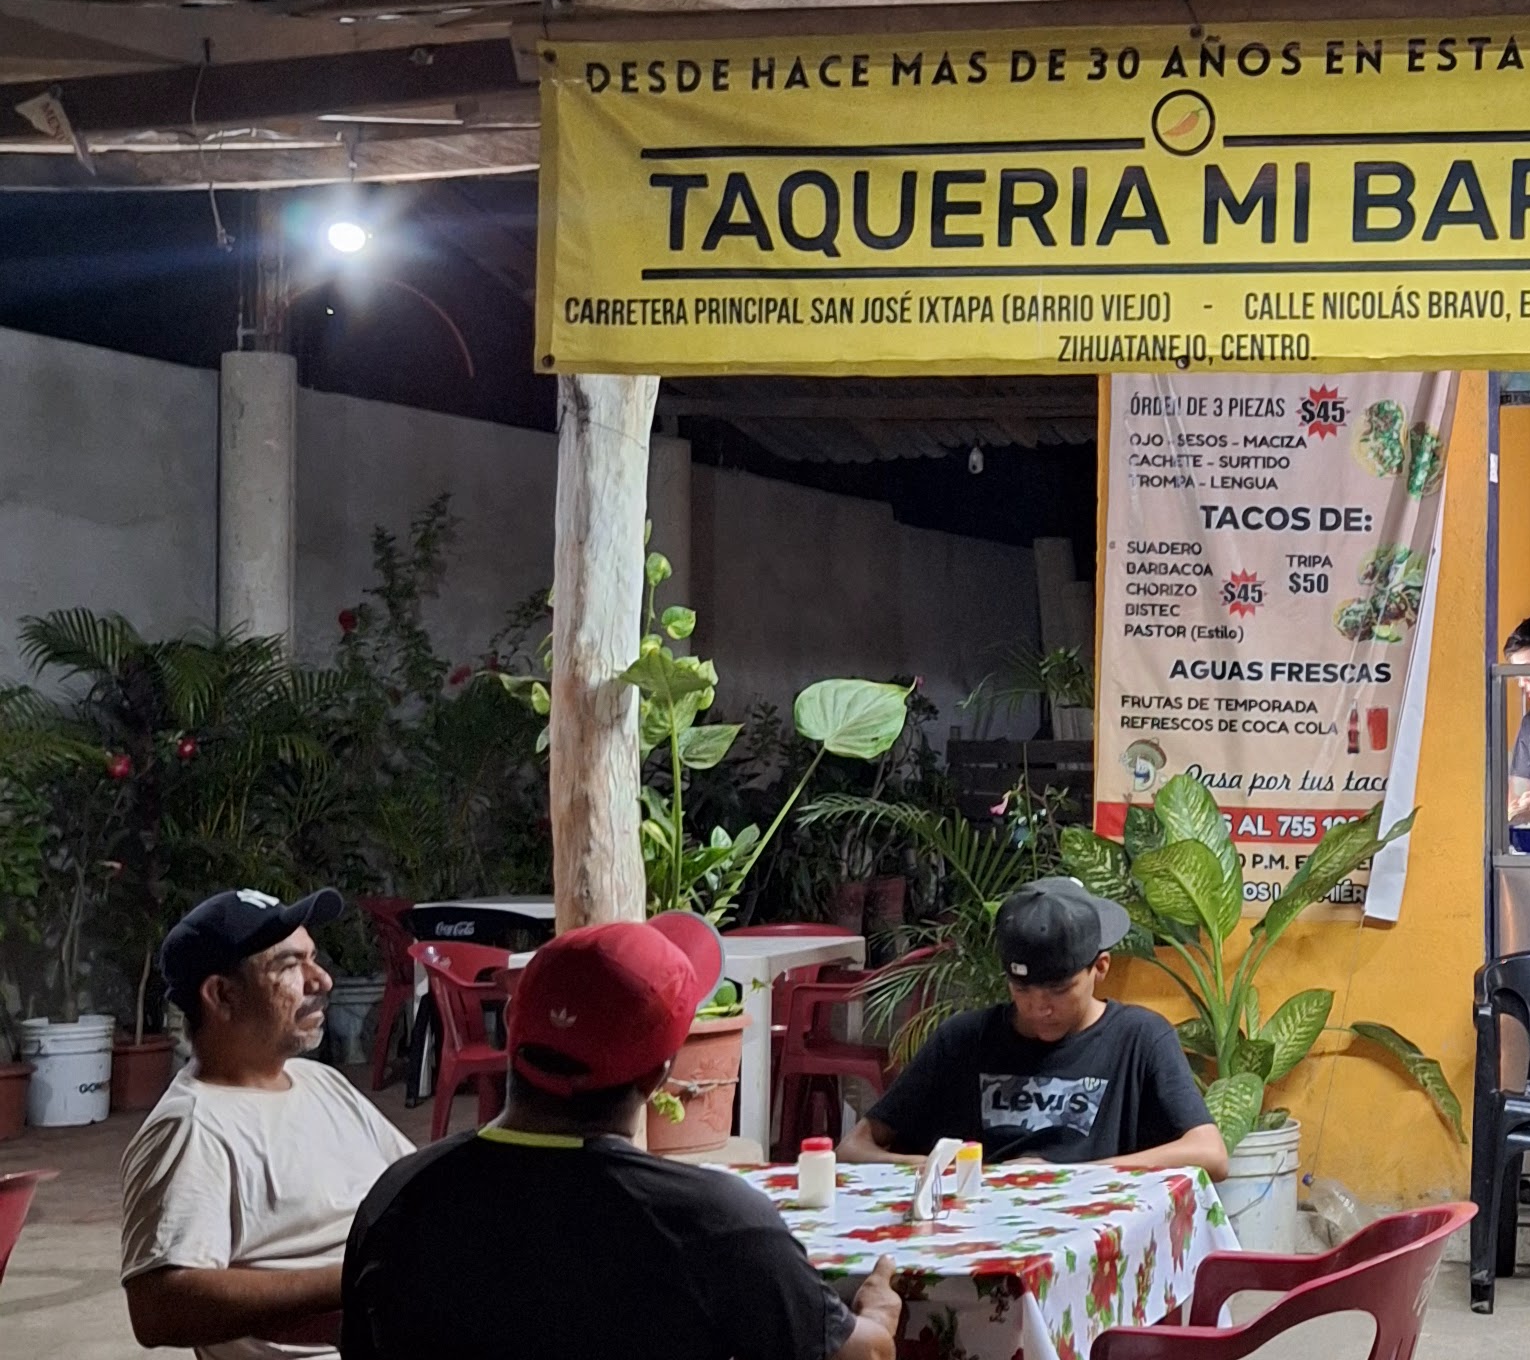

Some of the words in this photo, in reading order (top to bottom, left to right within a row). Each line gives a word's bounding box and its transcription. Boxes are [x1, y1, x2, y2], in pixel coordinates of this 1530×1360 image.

[586, 58, 730, 93] DESDE
[752, 54, 870, 89] HACE
[892, 50, 987, 85] MAS
[1011, 48, 1066, 82] DE
[1088, 45, 1140, 80] 30
[1161, 36, 1302, 80] AÑOS
[1326, 39, 1383, 74] EN
[1407, 34, 1526, 72] ESTA
[649, 166, 1170, 257] TAQUERIA
[1203, 162, 1310, 244] MI
[565, 297, 687, 325] CARRETERA
[695, 298, 803, 324] PRINCIPAL
[811, 298, 853, 323] SAN
[861, 291, 912, 323] JOSÉ
[919, 296, 993, 323] IXTAPA
[1003, 294, 1093, 324] (BARRIO
[1102, 292, 1170, 322] VIEJO)
[1245, 292, 1314, 320] CALLE
[1323, 285, 1420, 319] NICOLÁS
[1429, 290, 1510, 322] BRAVO,
[1058, 334, 1214, 366] ZIHUATANEJO,
[1221, 333, 1317, 361] CENTRO.
[1187, 397, 1207, 416] DE
[1214, 398, 1222, 416] 3
[1229, 398, 1284, 417] PIEZAS
[1300, 398, 1345, 424] $45
[1130, 433, 1163, 446] OJO
[1178, 433, 1227, 447] SESOS
[1244, 436, 1306, 448] MACIZA
[1219, 456, 1290, 469] SURTIDO
[1211, 476, 1278, 489] LENGUA
[1200, 506, 1310, 531] TACOS
[1320, 508, 1372, 531] DE:
[1128, 541, 1202, 555] SUADERO
[1127, 562, 1213, 576] BARBACOA
[1286, 555, 1332, 568] TRIPA
[1126, 583, 1197, 596] CHORIZO
[1223, 581, 1262, 604] $45
[1289, 572, 1328, 594] $50
[1126, 604, 1180, 616] BISTEC
[1125, 624, 1186, 637] PASTOR
[1191, 625, 1243, 643] (Estilo)
[1170, 660, 1262, 680] AGUAS
[1271, 663, 1391, 683] FRESCAS
[1122, 695, 1182, 709] FRUTAS
[1188, 698, 1209, 710] DE
[1214, 698, 1317, 713] TEMPORADA
[1121, 716, 1213, 731] REFRESCOS
[1219, 719, 1237, 732] DE
[1242, 720, 1289, 733] COCA
[1295, 722, 1337, 734] COLA
[1248, 773, 1291, 797] por
[1298, 769, 1335, 791] tus
[1238, 814, 1272, 836] AL
[1278, 815, 1317, 838] 755
[1252, 854, 1289, 869] P.M.
